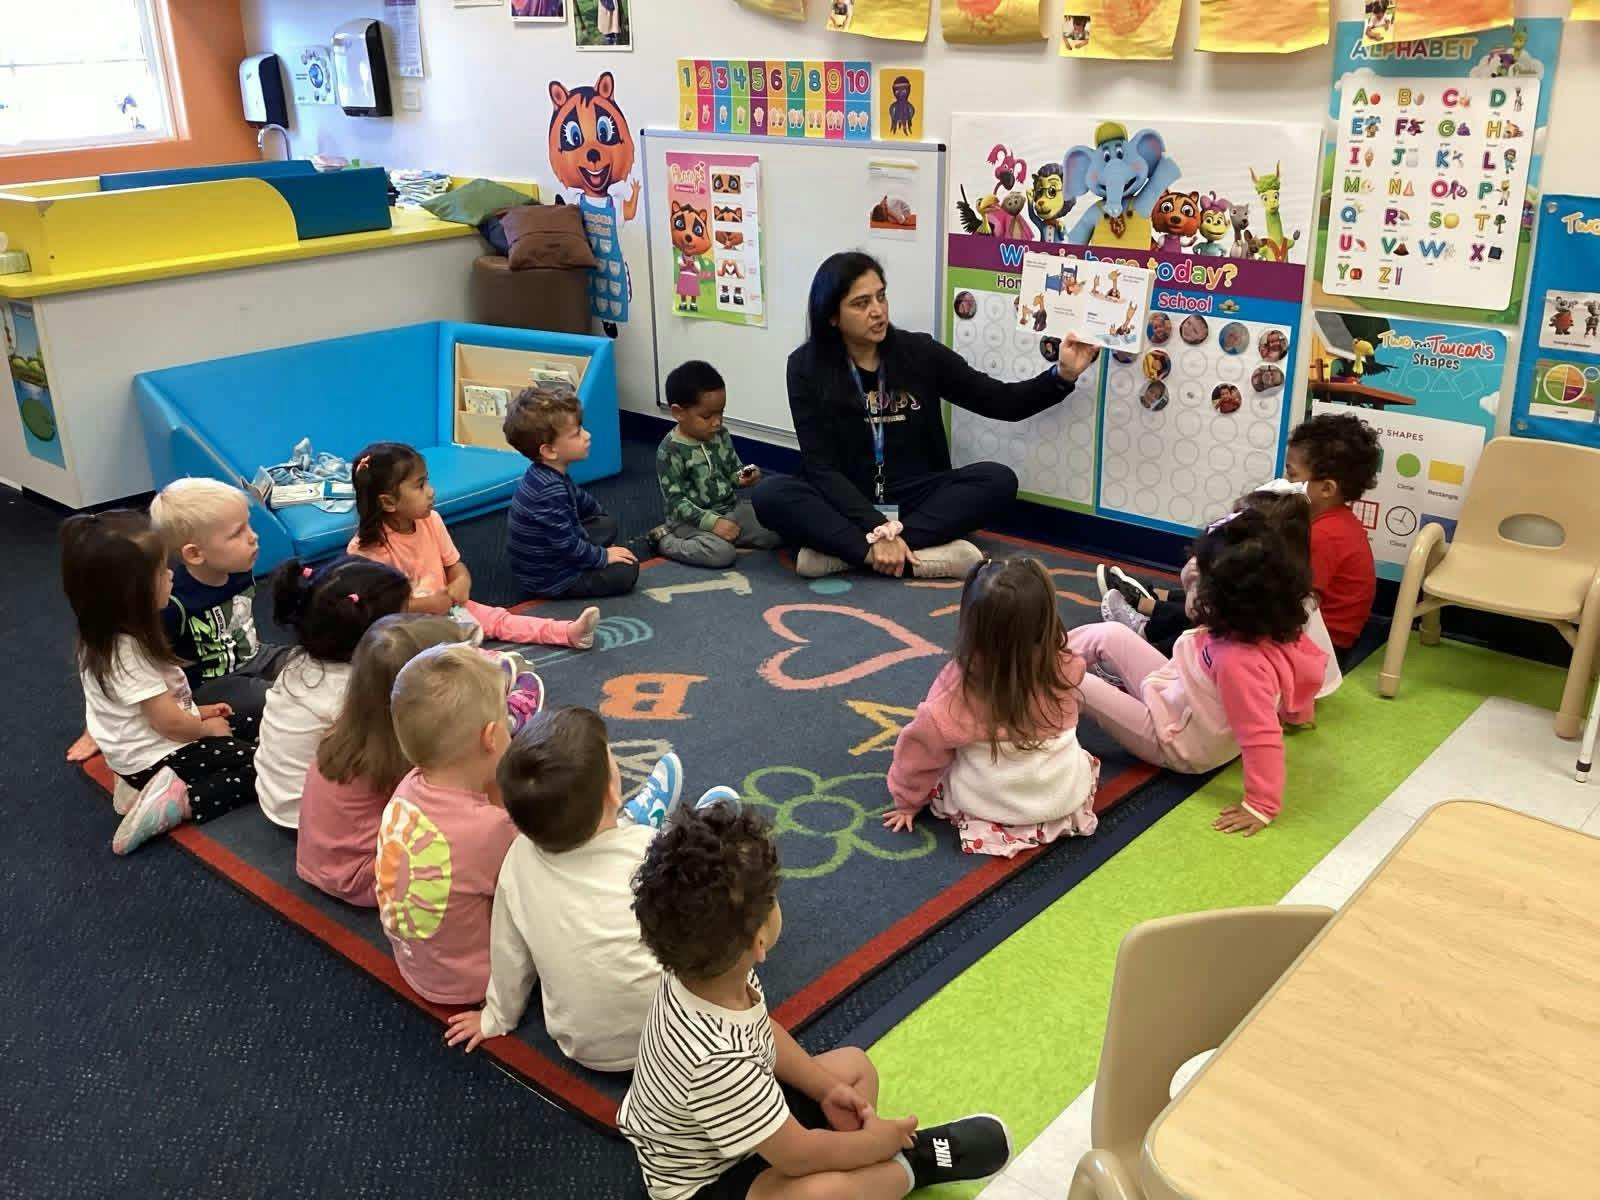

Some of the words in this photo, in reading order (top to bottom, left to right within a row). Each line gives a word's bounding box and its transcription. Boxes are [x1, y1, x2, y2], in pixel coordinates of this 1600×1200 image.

[1351, 37, 1479, 61] ALPHABET
[683, 67, 691, 88] 1
[699, 67, 711, 90] 2
[716, 67, 728, 90] 3
[733, 67, 747, 91] 4
[751, 67, 765, 92] 5
[770, 68, 783, 91] 6
[790, 69, 802, 93] 7
[808, 69, 821, 91] 8
[827, 69, 843, 93] 9
[847, 70, 871, 94] 10
[1352, 87, 1369, 106] A
[1398, 88, 1412, 106] B
[1442, 89, 1459, 107] C
[1489, 88, 1506, 107] D
[1351, 117, 1364, 135] E
[1395, 118, 1408, 136] F
[1438, 119, 1455, 137] G
[1487, 120, 1502, 138] H
[1350, 147, 1360, 164] I
[1392, 148, 1406, 166] J
[1436, 149, 1449, 168] K
[1483, 151, 1496, 169] L
[1343, 176, 1360, 193] M
[1389, 178, 1401, 196] N
[1431, 180, 1448, 198] O
[1478, 182, 1493, 200] P
[1341, 206, 1357, 223] Q
[1385, 208, 1399, 225] R
[1429, 211, 1442, 228] S
[1474, 213, 1491, 231] T
[1340, 234, 1352, 251] U
[1381, 237, 1397, 254] V
[1418, 240, 1446, 258] W
[1470, 243, 1485, 261] X
[1337, 263, 1350, 280] Y
[1378, 266, 1392, 283] Z
[1158, 292, 1213, 312] School
[1377, 330, 1412, 348] Two
[1425, 335, 1495, 360] Toucan's
[1412, 353, 1460, 371] Shapes
[1386, 429, 1424, 442] SHAPES
[599, 672, 708, 721] B
[932, 1137, 953, 1168] NIKE
